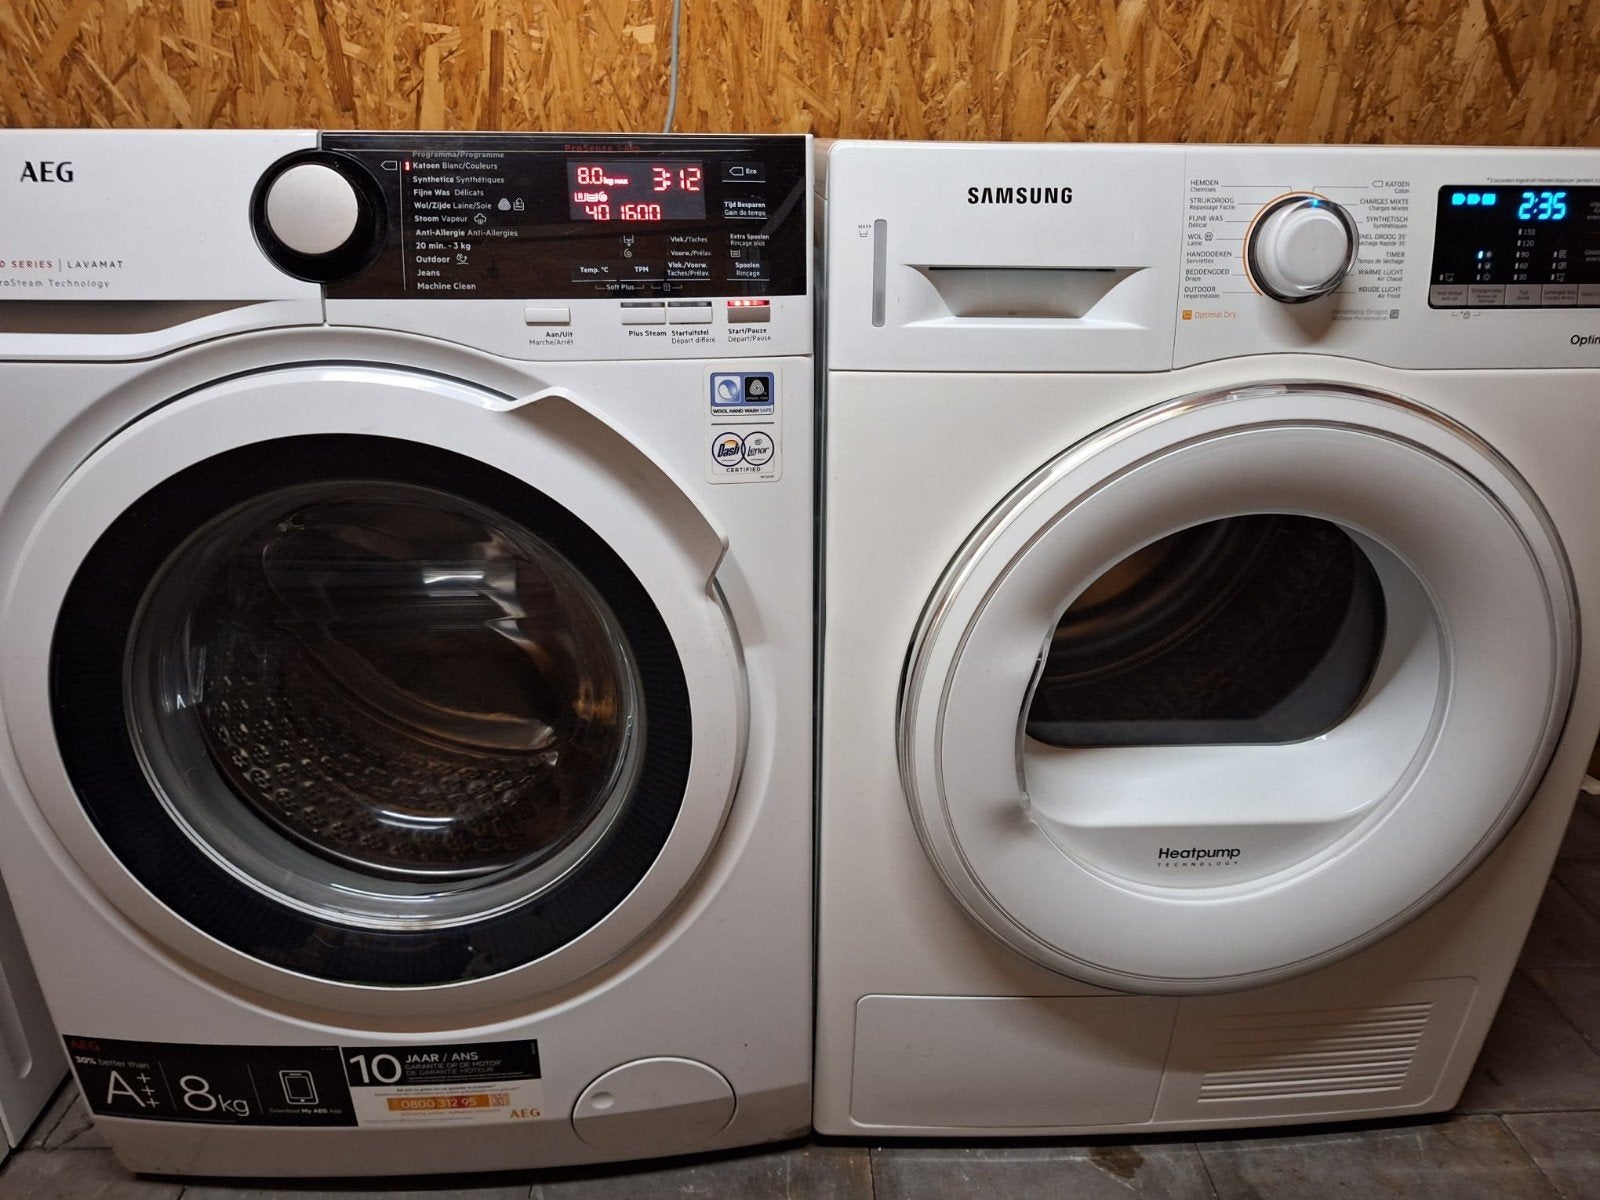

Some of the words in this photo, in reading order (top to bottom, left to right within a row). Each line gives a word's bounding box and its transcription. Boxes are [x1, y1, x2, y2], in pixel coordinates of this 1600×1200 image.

[412, 151, 504, 159] Programma/Programme
[412, 162, 440, 170] Katoen
[442, 162, 498, 170] Blanc/Couleurs
[20, 160, 74, 183] AEG
[412, 176, 454, 184] Synthetica
[456, 175, 505, 184] Synthétiques
[652, 167, 701, 191] 3:12
[413, 189, 433, 197] Fijne
[454, 188, 484, 196] Délicats
[967, 187, 1073, 204] SAMSUNG
[414, 202, 451, 210] Wol/Zijde
[453, 202, 492, 210] Laine/Soie
[724, 201, 735, 209] Tijd
[737, 201, 766, 209] Besparen
[1518, 192, 1567, 219] 2:35
[585, 204, 610, 220] 40
[621, 204, 661, 220] 1600
[441, 215, 468, 223] Vapeur
[415, 229, 466, 237] Anti-Allergie
[467, 229, 519, 238] Anti-Allergies
[747, 233, 770, 241] Spoelen
[415, 242, 427, 250] 20
[428, 242, 447, 250] min.
[453, 242, 459, 250] 3
[460, 242, 471, 251] kg
[730, 240, 753, 248] Rinçage
[754, 240, 766, 248] plus
[415, 255, 451, 263] Outdoor
[11, 260, 53, 268] SERIES
[67, 260, 124, 269] LAVAMAT
[735, 262, 760, 270] Spoelen
[416, 269, 441, 277] Jeans
[579, 266, 600, 274] Temp.
[667, 269, 710, 277] Taches/Prélav.
[736, 270, 760, 278] Rinçage
[0, 279, 43, 288] roSteam
[47, 279, 110, 289] Technology
[417, 282, 451, 290] Machine
[453, 282, 477, 290] Clean
[606, 283, 620, 291] Soft
[1194, 309, 1222, 319] Optimal
[1223, 309, 1236, 319] Dry
[529, 338, 574, 346] Marche/Arrêt
[671, 337, 694, 345] Départ
[728, 335, 772, 343] Départ/Pause
[717, 443, 740, 458] Dash
[747, 445, 770, 457] Lenor
[1158, 847, 1241, 860] Heatpump
[71, 1041, 100, 1051] AEG
[75, 1055, 97, 1066] 30%
[98, 1059, 126, 1068] better
[128, 1061, 150, 1069] than
[406, 1053, 439, 1063] JAAR
[452, 1052, 479, 1061] ANS
[350, 1053, 402, 1084] 10
[180, 1075, 217, 1112] 8
[218, 1094, 250, 1116] kg
[401, 1101, 435, 1109] 0800
[440, 1099, 459, 1107] 312
[510, 1109, 541, 1118] AEG
